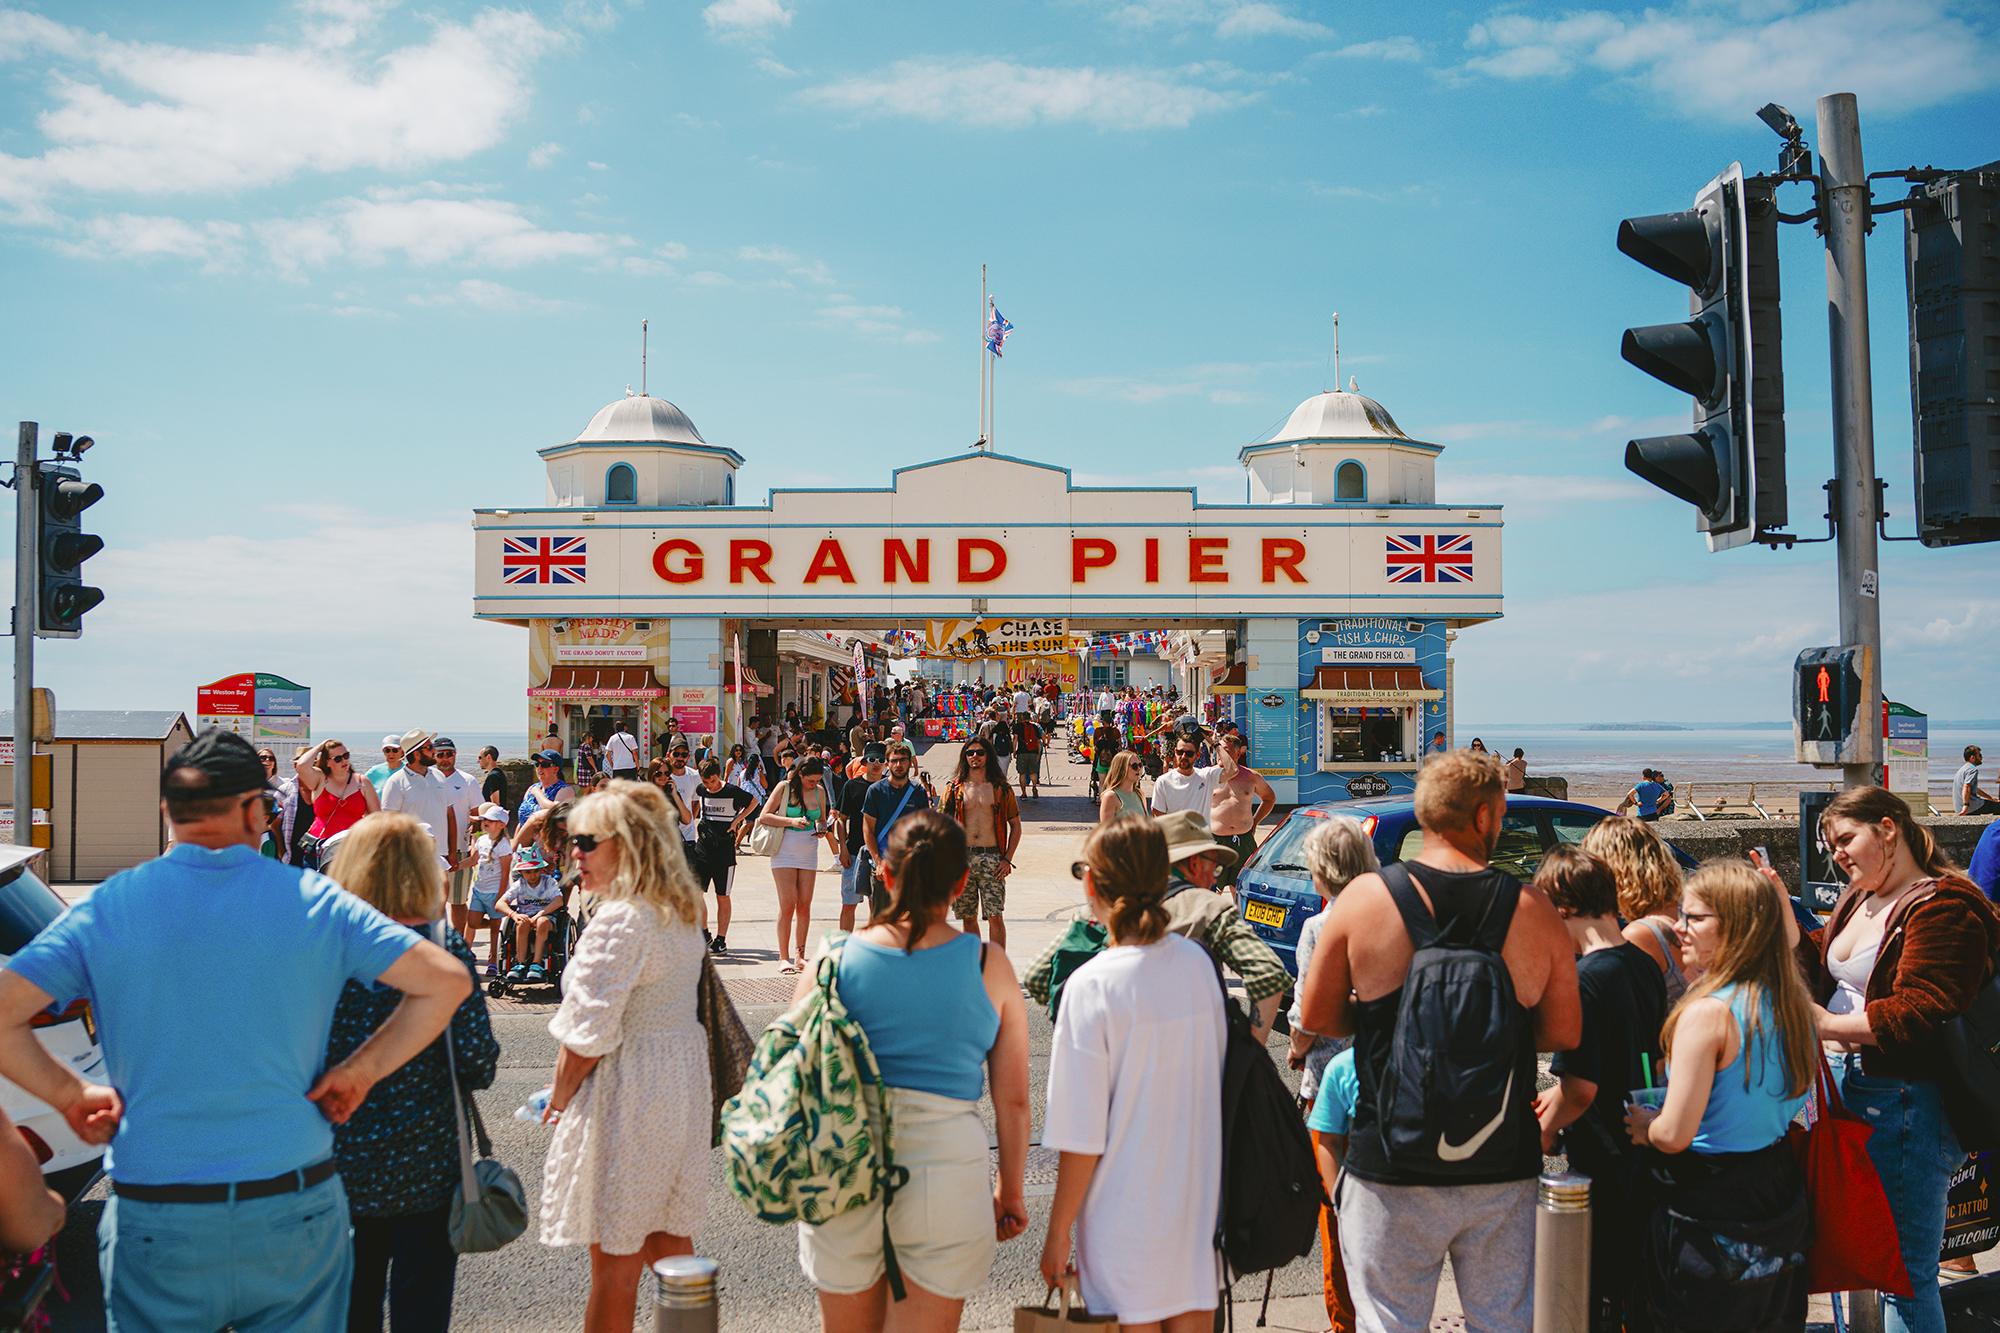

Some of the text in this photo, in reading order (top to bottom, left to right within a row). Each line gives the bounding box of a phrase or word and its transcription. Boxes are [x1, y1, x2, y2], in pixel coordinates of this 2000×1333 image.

[652, 538, 1308, 584] GRAND PIER
[569, 618, 632, 630] FRESHLY
[1001, 622, 1062, 637] CHASE
[1340, 618, 1404, 632] TRADITIONAL
[580, 628, 620, 639] MADE
[1338, 631, 1406, 646] FISH & CHIPS
[1000, 640, 1062, 652] THE SUN
[1333, 651, 1405, 659] THE GRAND FISH CO.
[1958, 1198, 1989, 1217] TATTOO
[1948, 1225, 2000, 1249] WELCOME!
